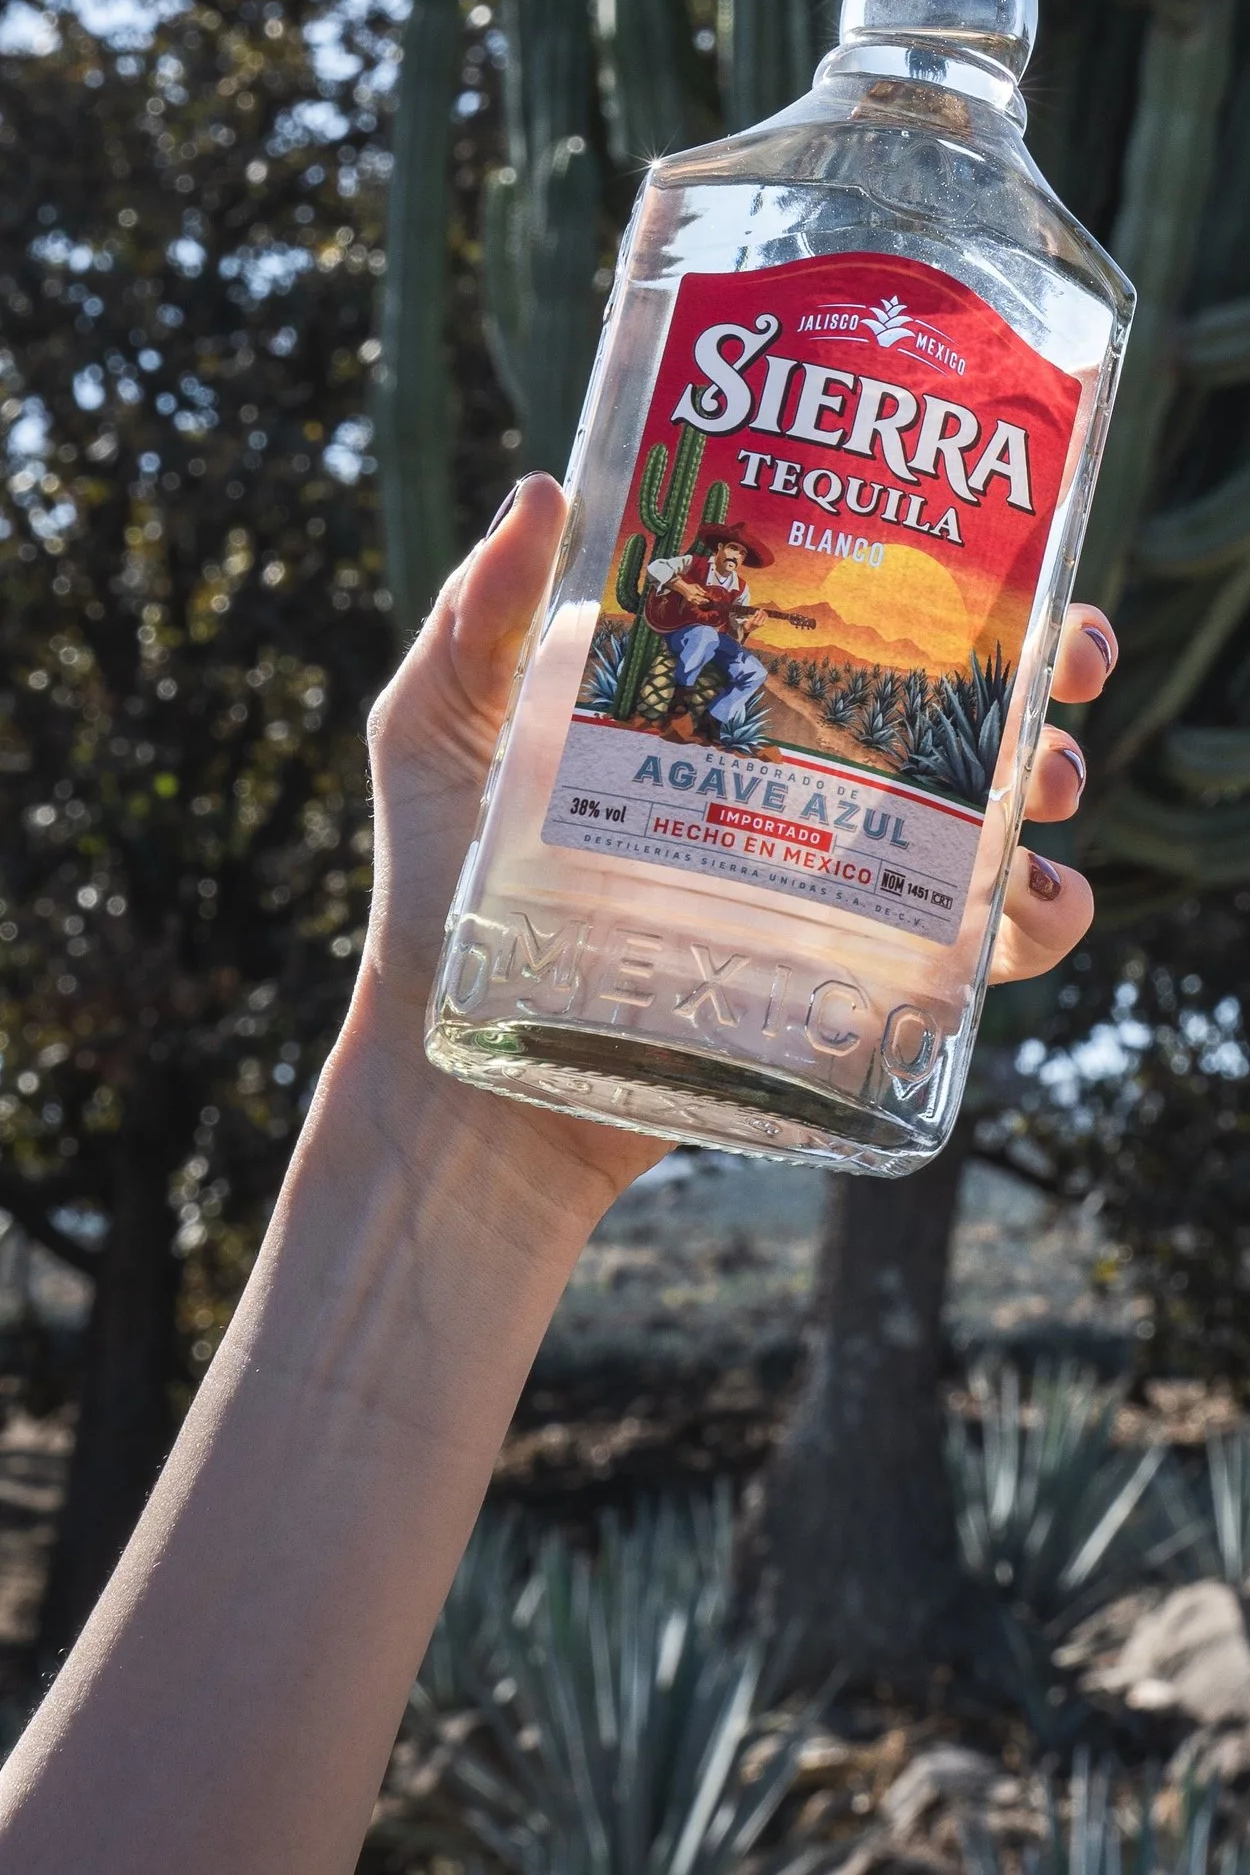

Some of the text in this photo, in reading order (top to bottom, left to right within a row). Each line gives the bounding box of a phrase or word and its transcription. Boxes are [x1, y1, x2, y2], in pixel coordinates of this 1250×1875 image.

[798, 312, 966, 376] JALISCO MEXICO
[670, 312, 1036, 515] SIERRA
[737, 449, 964, 547] TEQUILA
[788, 520, 885, 568] BLANCO
[570, 796, 627, 823] 38% vol
[631, 755, 910, 850] AGAVE AZUL
[705, 754, 858, 800] ELABORADO DE
[652, 817, 872, 885] HECHO EN MEXICO
[719, 809, 820, 845] IMPORTADO
[584, 834, 692, 862] DESTILERIAS
[700, 857, 759, 878] SIERRA
[769, 873, 828, 897] UNIDAS
[875, 905, 890, 915] DE
[881, 872, 953, 909] NOM 1451 CRT
[491, 911, 941, 1082] MEXICO
